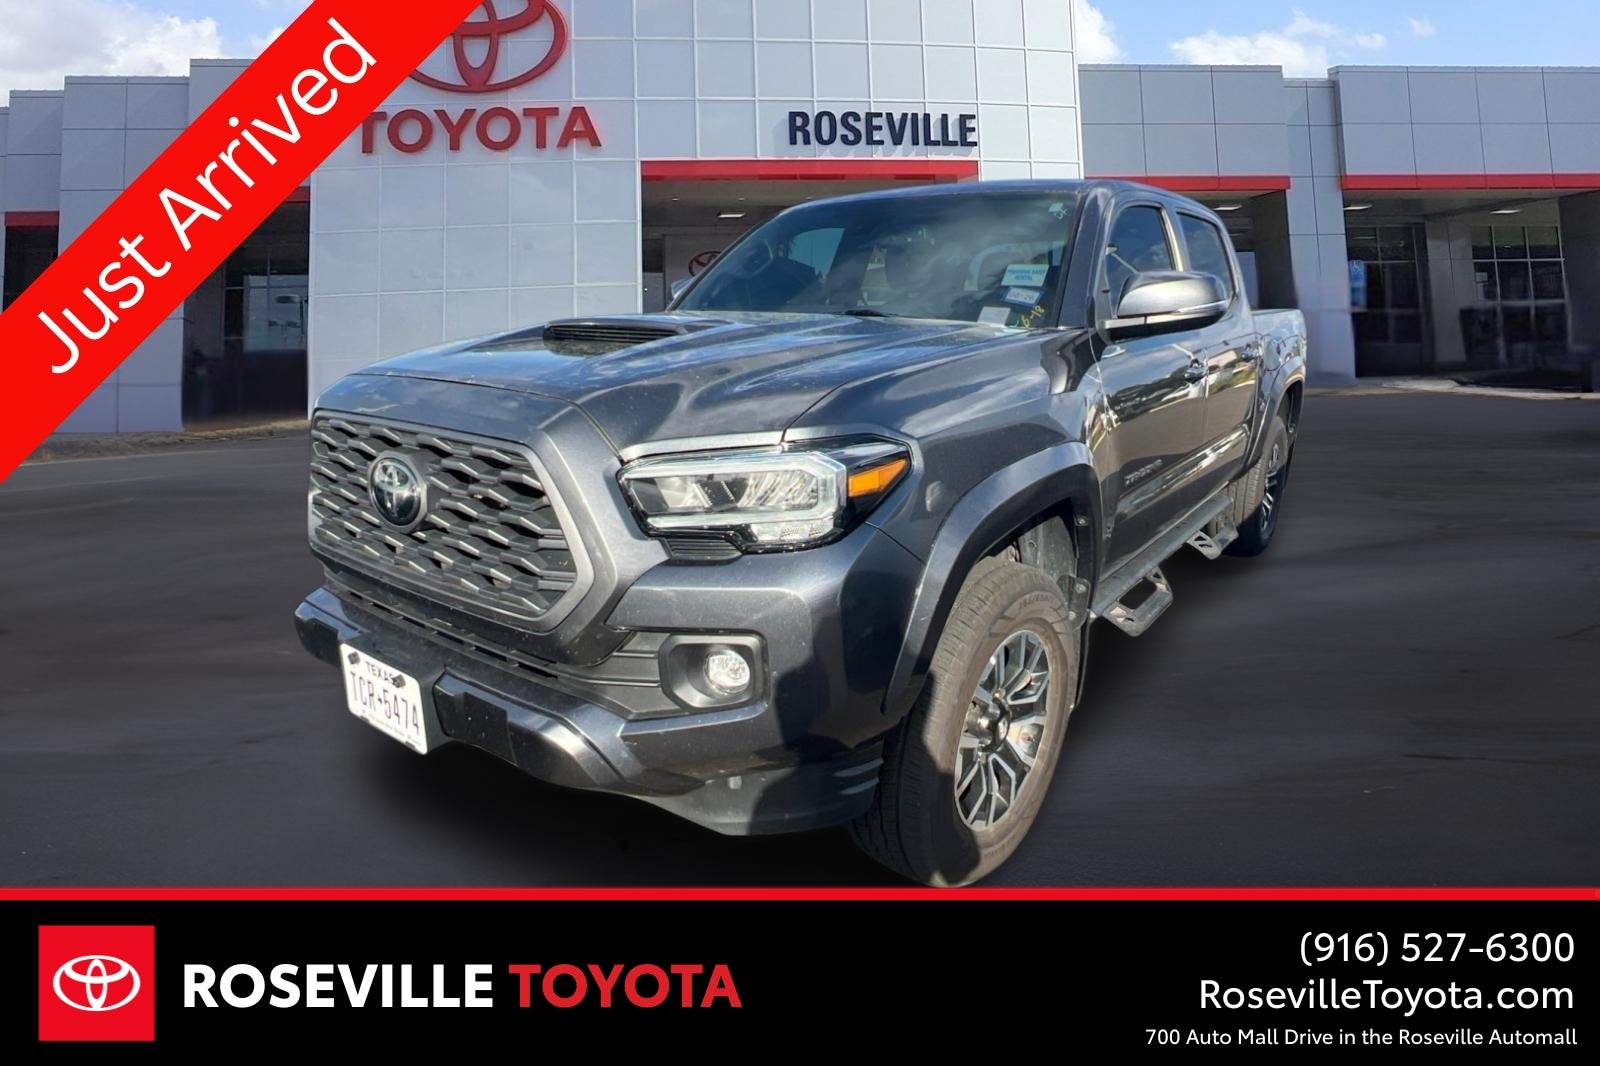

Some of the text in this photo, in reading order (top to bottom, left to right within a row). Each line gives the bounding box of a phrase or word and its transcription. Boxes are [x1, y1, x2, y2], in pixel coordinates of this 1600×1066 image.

[361, 106, 602, 154] TOYOTA
[788, 110, 978, 147] ROSEVILLE
[365, 660, 396, 685] TEXAS
